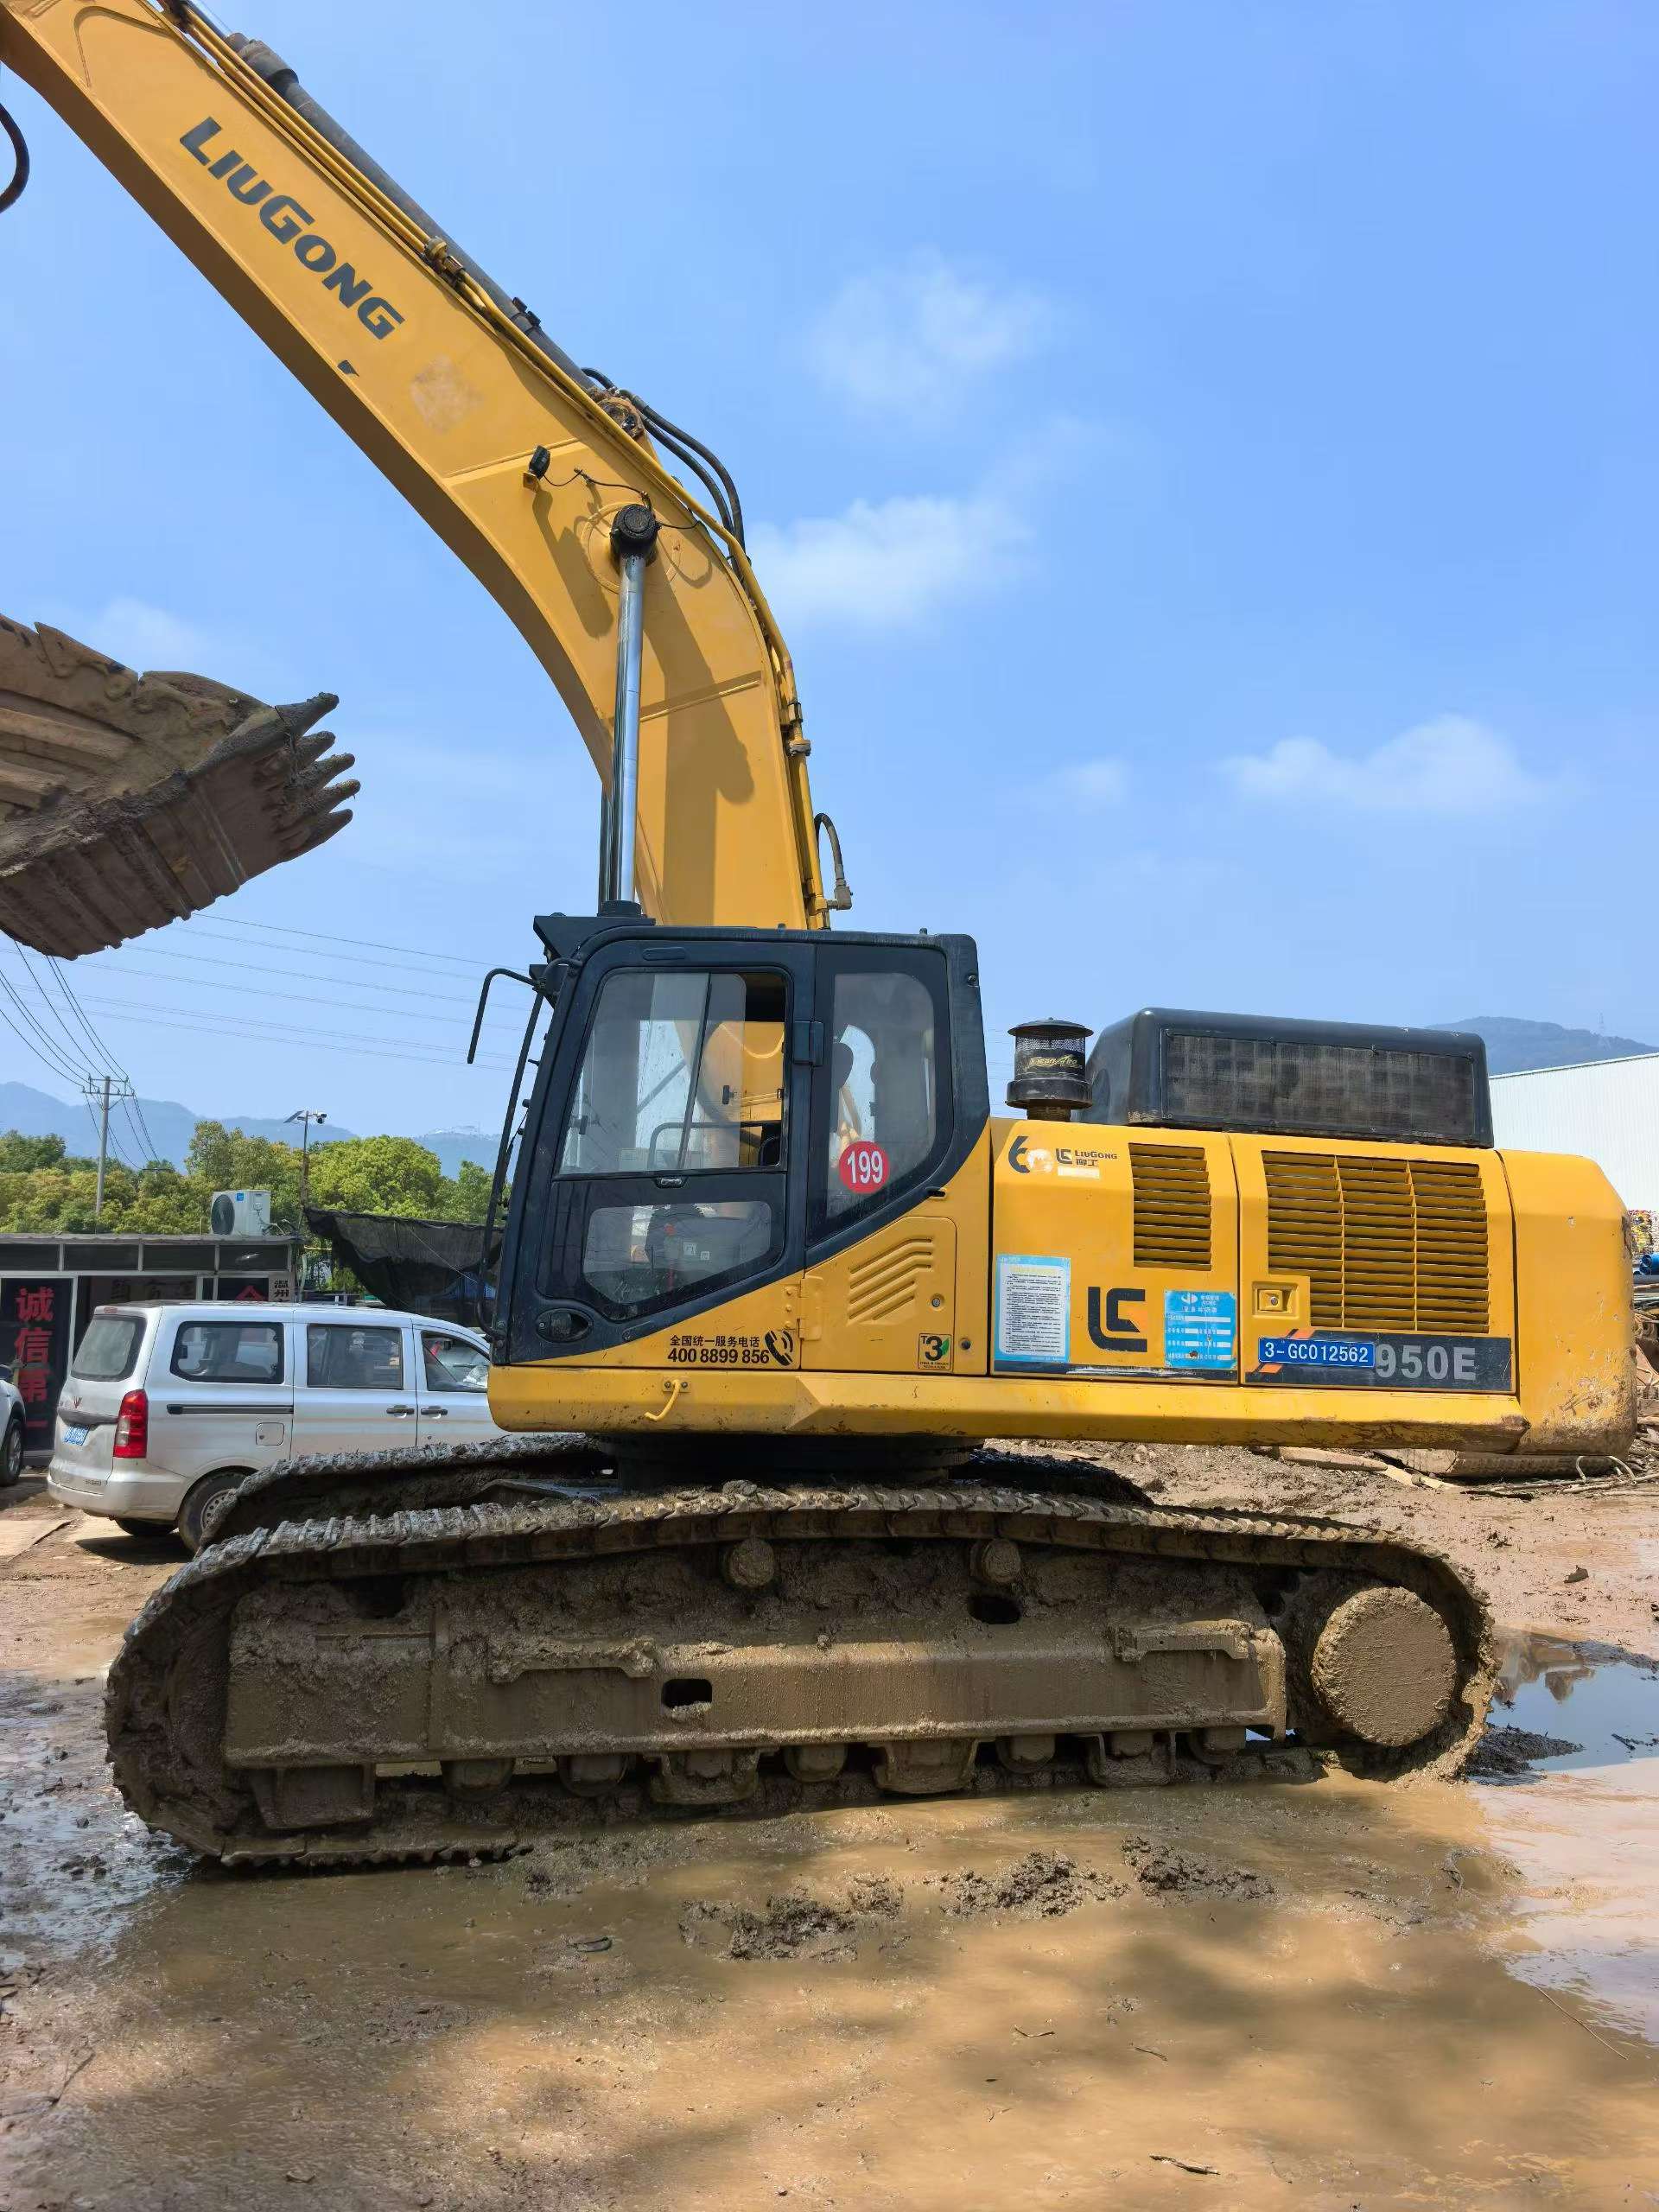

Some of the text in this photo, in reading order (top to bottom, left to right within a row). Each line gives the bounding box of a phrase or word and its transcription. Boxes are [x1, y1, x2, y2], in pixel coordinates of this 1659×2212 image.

[180, 117, 405, 340] LIUGONG
[847, 1150, 883, 1184] 199
[670, 1335, 760, 1348] 全国统一服务电话
[667, 1348, 770, 1363] 400 8899 856
